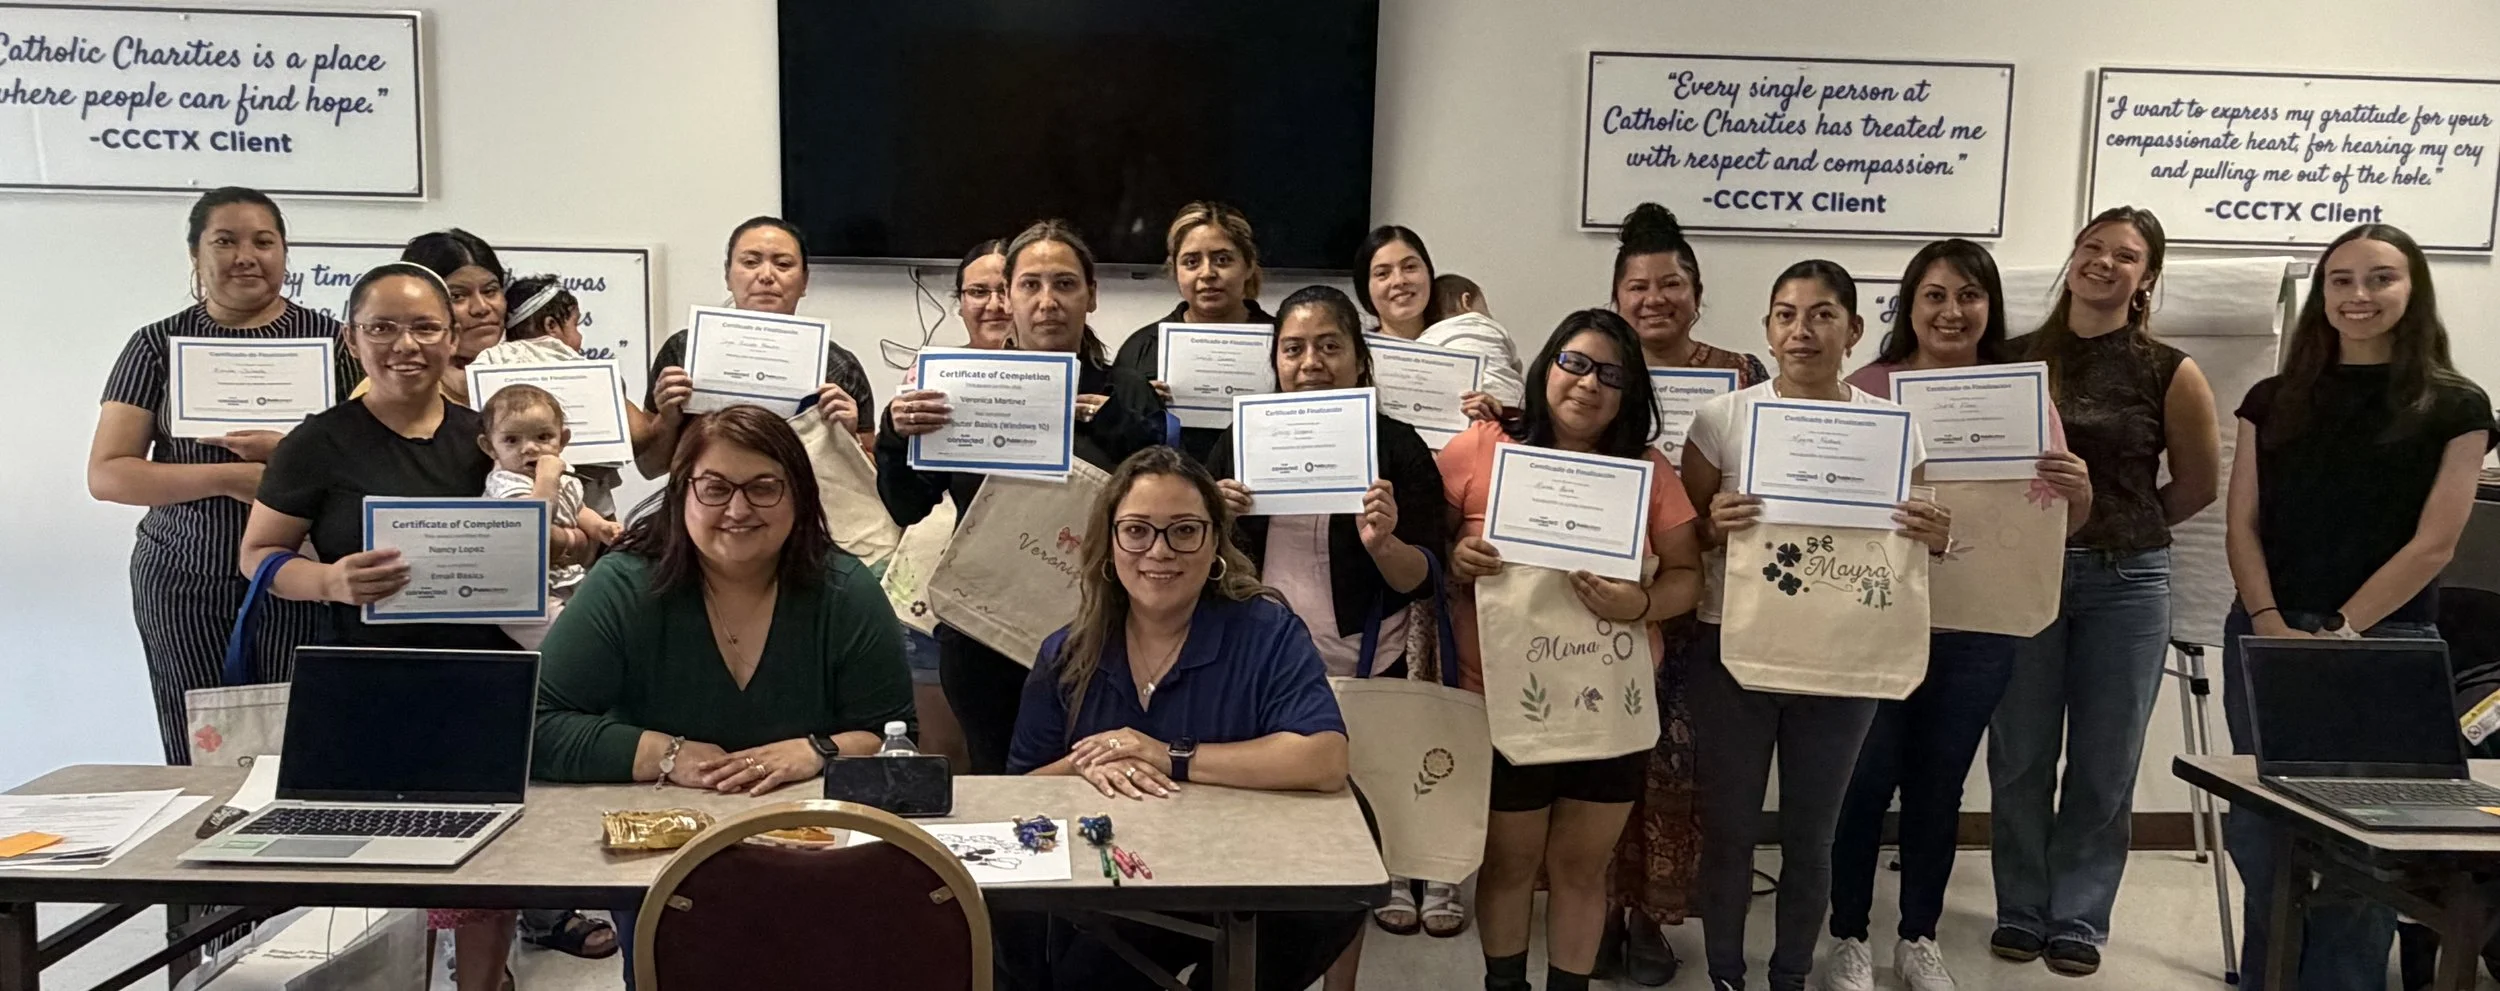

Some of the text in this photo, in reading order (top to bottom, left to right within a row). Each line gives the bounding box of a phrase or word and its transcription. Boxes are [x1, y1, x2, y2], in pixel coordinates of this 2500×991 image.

[113, 35, 241, 69] Charities
[254, 43, 274, 70] is
[287, 52, 307, 70] a
[311, 44, 386, 83] place
[80, 81, 173, 120] people
[179, 90, 230, 110] can
[234, 84, 299, 125] find
[305, 86, 389, 127] hope.”
[1668, 71, 1931, 111] “Every single person at
[1603, 106, 1988, 141] Catholic Charities has treated me
[2106, 96, 2492, 137] “I want to express my gratitude for your
[89, 129, 292, 154] -CCCTX Client
[2106, 129, 2484, 168] compassionate heart, for hearing my cry
[1626, 145, 1968, 185] with respect and compassion.”
[2150, 160, 2443, 194] and pulling me out of the hole.”
[1702, 190, 1886, 213] -CCCTX Client
[2204, 200, 2383, 224] -CCCTX Client
[563, 276, 606, 292] was
[939, 370, 1050, 382] Certificate of Completion
[392, 519, 521, 530] Certificate of Completion
[429, 546, 485, 554] Nancy Lopez
[1019, 532, 1081, 580] Veroni
[1804, 555, 1890, 583] Mayra
[1526, 635, 1599, 663] Mirna
